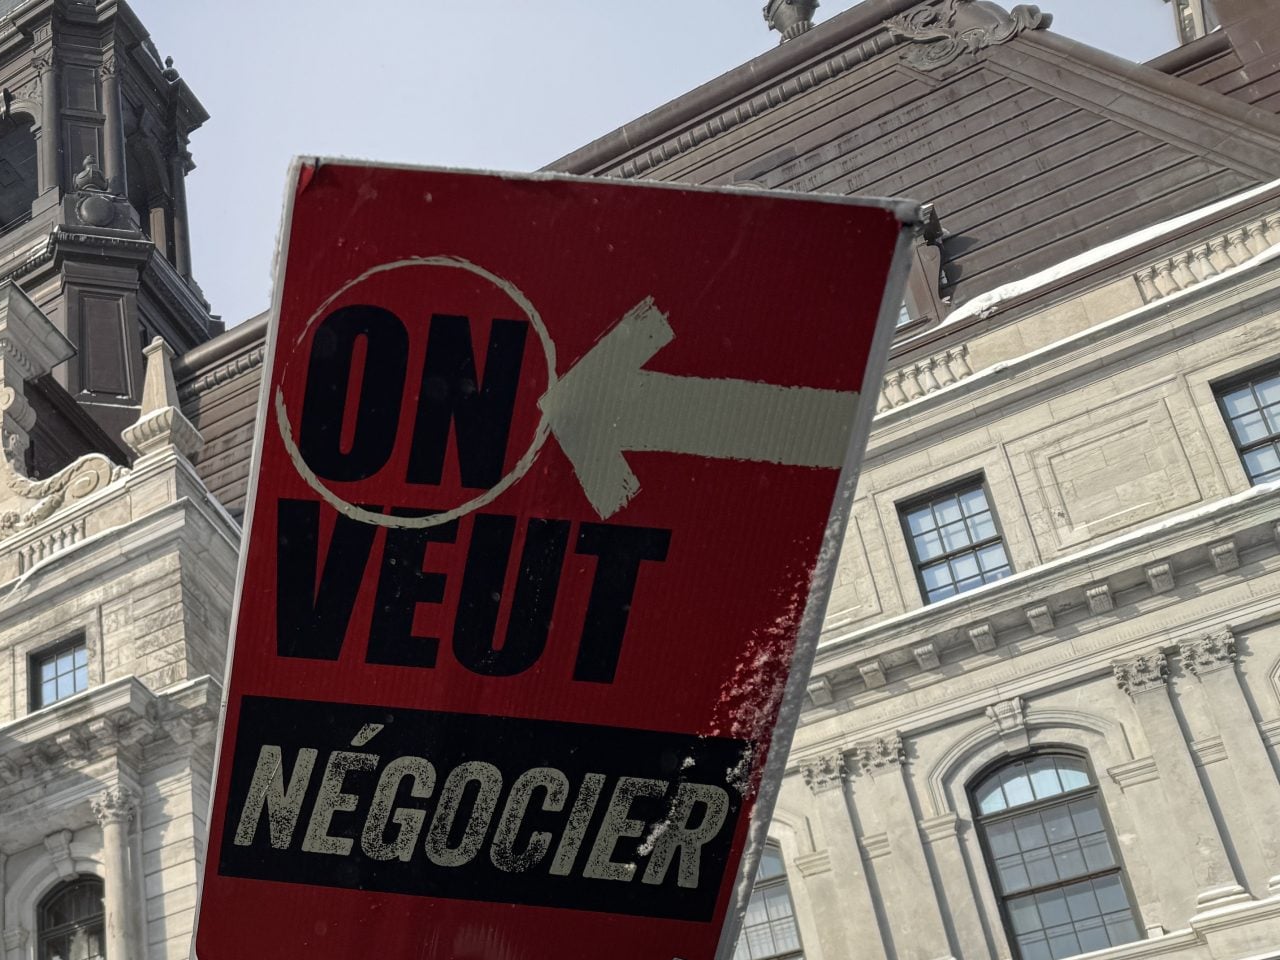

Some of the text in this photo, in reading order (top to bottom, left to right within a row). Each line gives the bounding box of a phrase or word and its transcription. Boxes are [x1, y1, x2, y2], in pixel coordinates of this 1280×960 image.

[297, 303, 531, 492] ON
[275, 497, 673, 685] VEUT
[232, 723, 731, 890] NÉGOCIER
